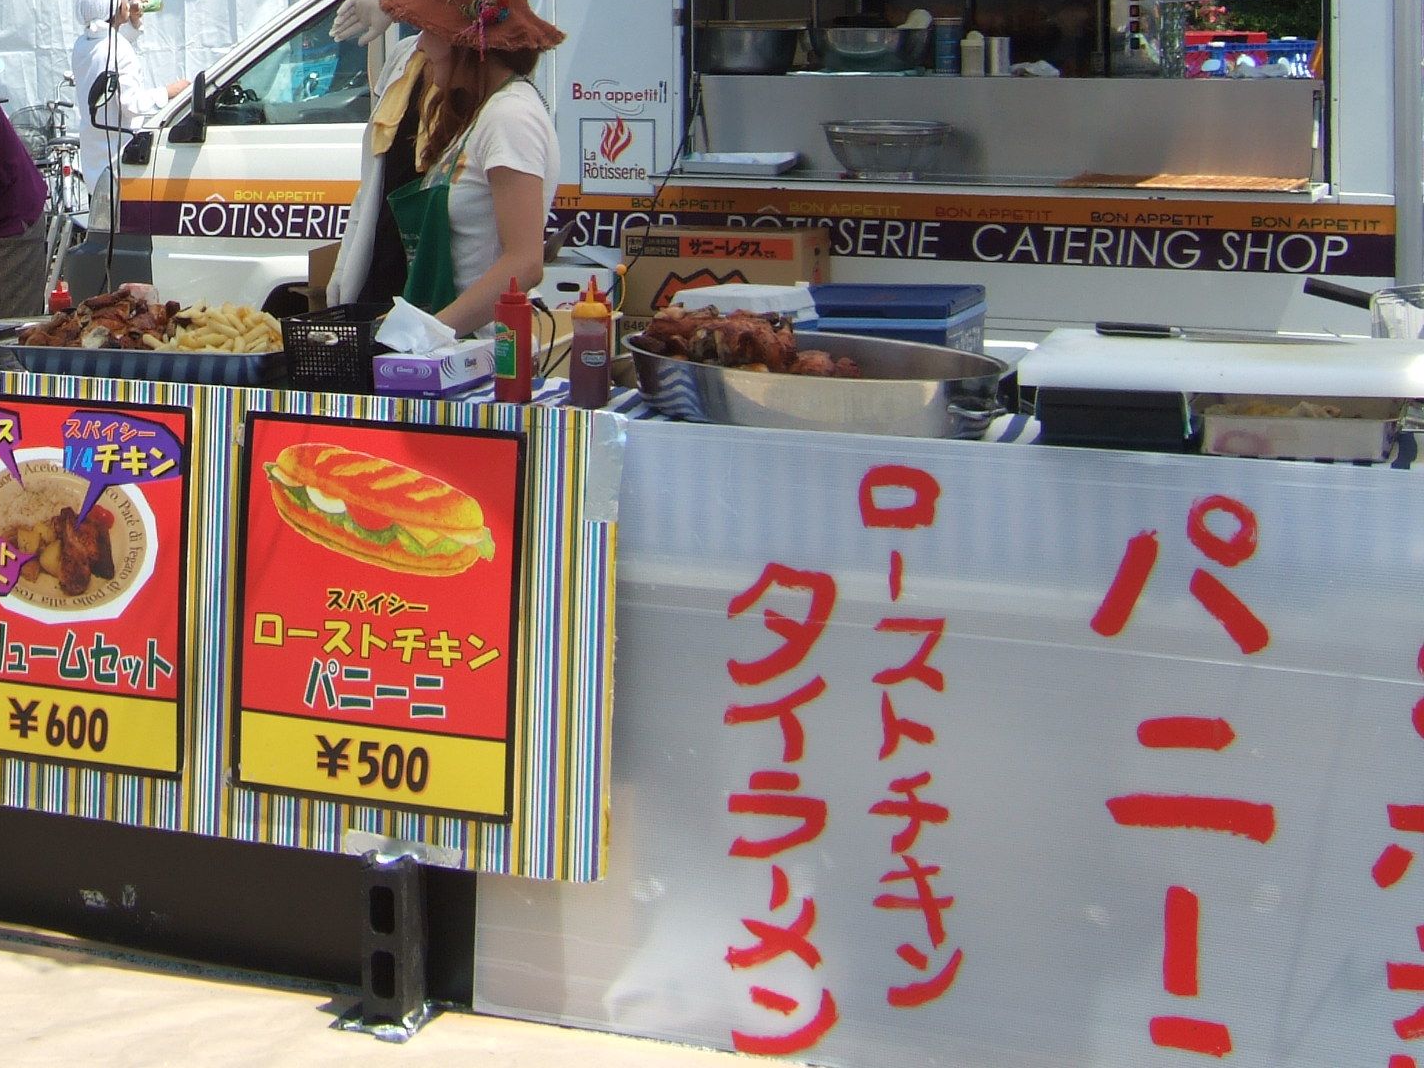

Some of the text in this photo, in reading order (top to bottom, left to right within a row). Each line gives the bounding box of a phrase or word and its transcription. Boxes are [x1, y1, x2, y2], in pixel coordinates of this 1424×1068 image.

[572, 82, 601, 100] Bon
[583, 148, 597, 161] La
[583, 162, 645, 180] Rôtisserie
[234, 190, 325, 202] BON APPETIT
[669, 200, 736, 211] APPETIT
[788, 201, 902, 217] BON APPETIT
[934, 206, 1052, 221] BON APPETIT
[1090, 211, 1214, 226] BON APPETIT
[1251, 216, 1381, 232] BON APPETIT
[972, 222, 1202, 270] CATERING
[1218, 230, 1349, 274] SHOP
[64, 419, 156, 442] スパイシー
[325, 588, 430, 616] スパイシー
[254, 612, 501, 671] ローストチキン
[303, 658, 446, 719] パニーニ
[8, 696, 109, 753] ¥600
[857, 464, 964, 1008] ローストチキン
[315, 734, 431, 794] ¥500
[723, 562, 838, 1057] タイラーメン
